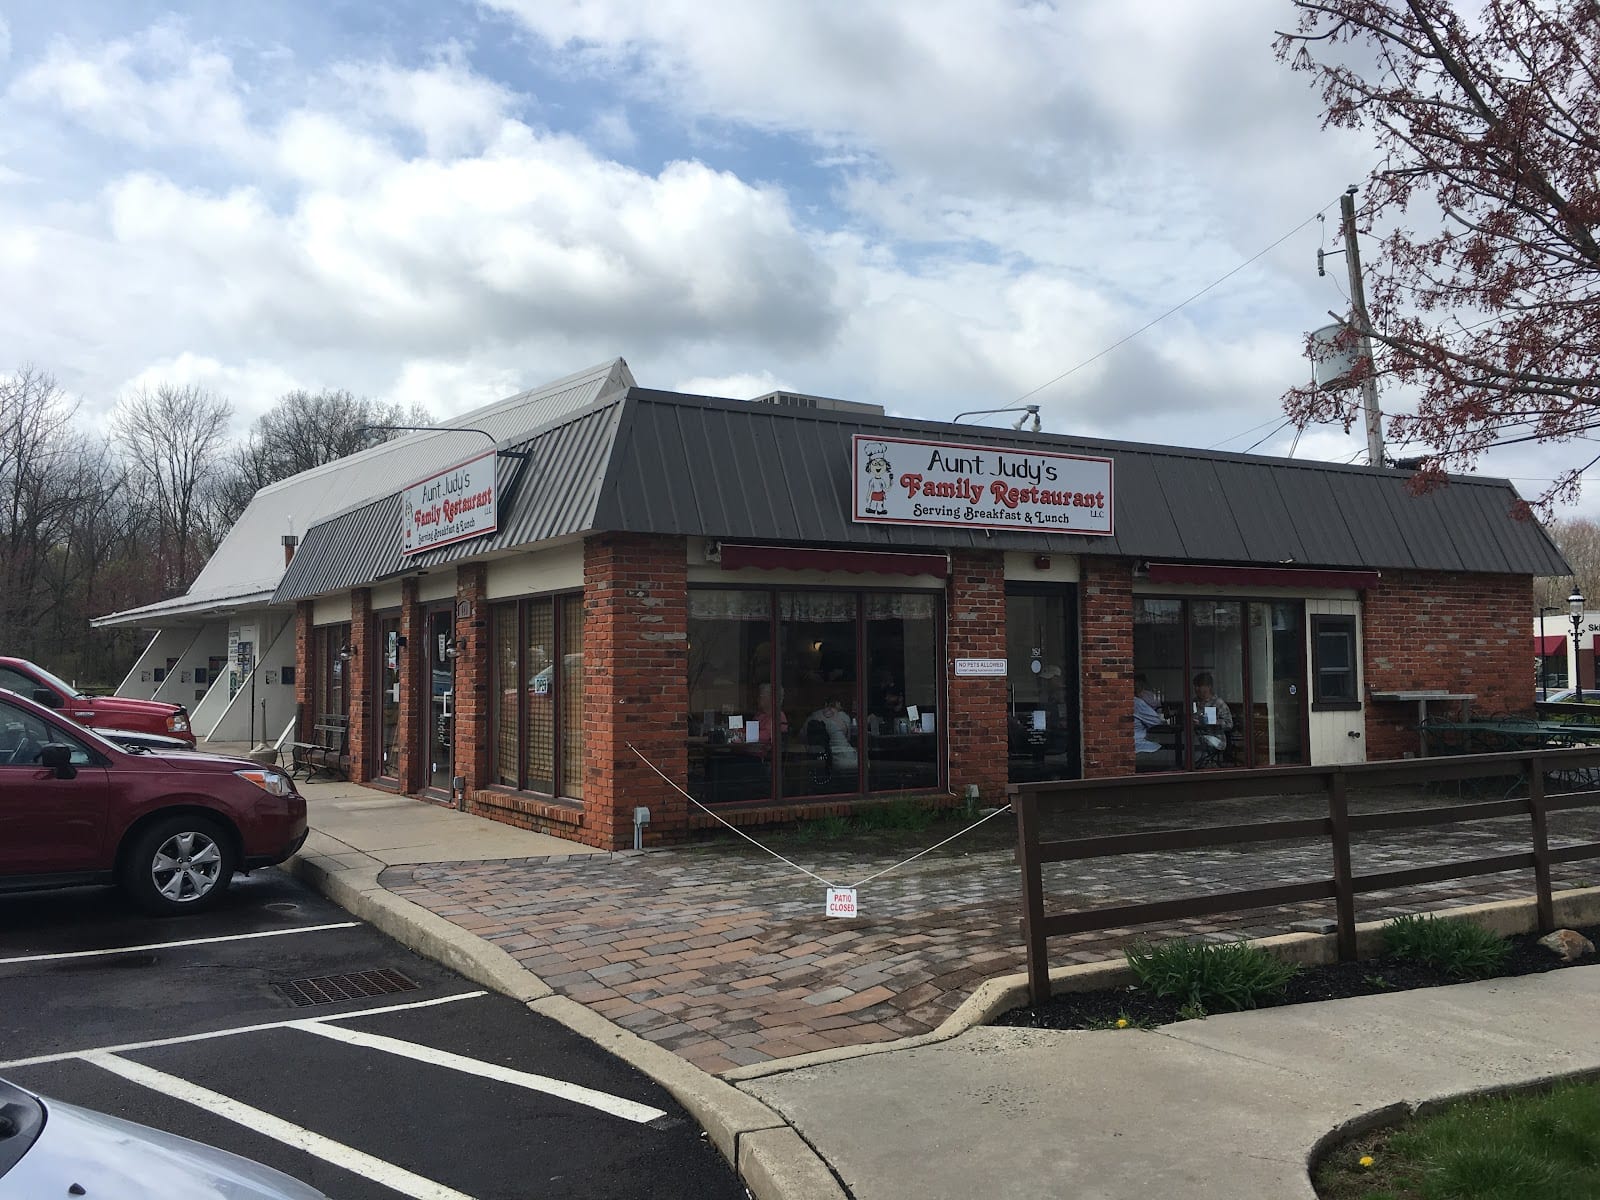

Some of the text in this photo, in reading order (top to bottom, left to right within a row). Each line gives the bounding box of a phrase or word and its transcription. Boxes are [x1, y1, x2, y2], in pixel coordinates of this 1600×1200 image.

[926, 449, 1058, 486] Aunt Judy's
[422, 469, 471, 505] Aunt Judy's
[899, 473, 1105, 509] Family Restaurant
[414, 486, 492, 531] Family Restaurant
[913, 503, 1070, 524] Serving Breakfast & Lunch
[1090, 510, 1105, 519] LLC
[830, 903, 855, 912] CLOSED
[834, 894, 852, 902] PATIO
